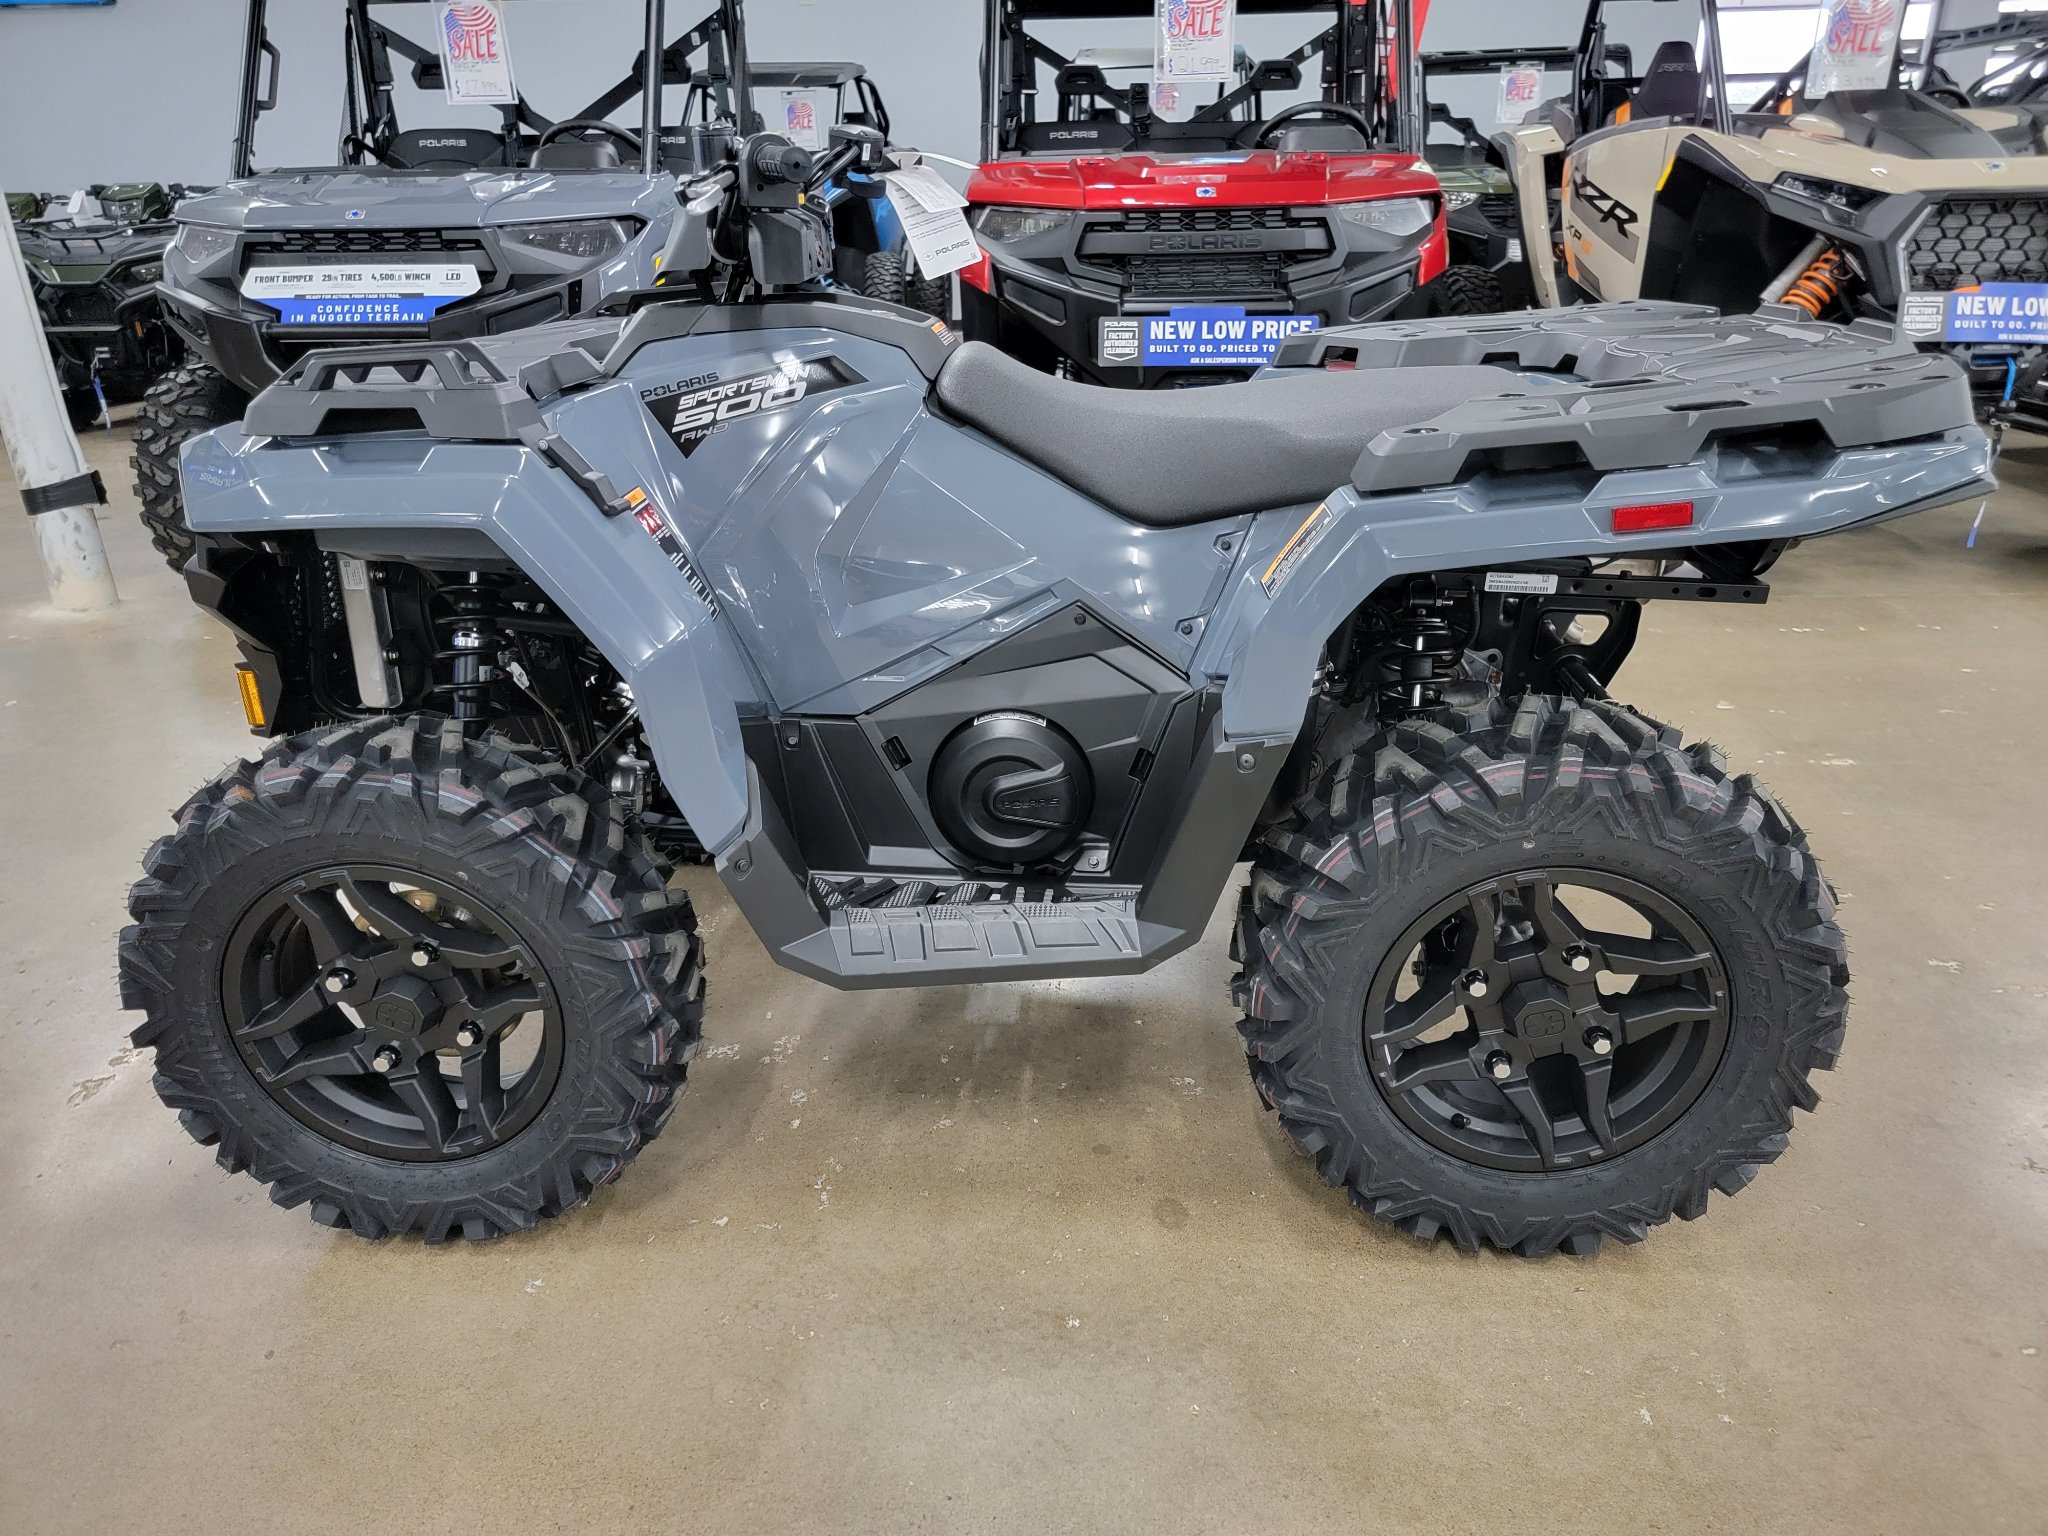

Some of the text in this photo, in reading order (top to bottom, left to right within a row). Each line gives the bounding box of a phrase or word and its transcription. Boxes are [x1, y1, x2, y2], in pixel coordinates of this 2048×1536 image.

[1170, 5, 1224, 38] SALE
[1827, 21, 1887, 53] SALE
[451, 29, 498, 60] SALE
[1505, 86, 1535, 102] SALE
[788, 114, 813, 130] SALE
[660, 136, 687, 144] ARIS
[1049, 130, 1099, 140] POLARIS
[418, 139, 468, 148] POLARIS
[1572, 166, 1639, 240] RZR
[935, 239, 971, 257] POLARIS
[1150, 233, 1263, 250] POLARIS
[254, 274, 314, 285] FRONT BUMPER
[340, 273, 363, 282] TIRES
[404, 272, 431, 281] WINCH
[445, 272, 461, 281] LED
[317, 304, 400, 314] CONFIDENCE
[1908, 307, 1938, 315] FACTORY
[1956, 296, 2007, 316] NEW
[290, 312, 424, 323] IN RUGGED TERRAIN
[1150, 320, 1313, 340] NEW LOW PRICE
[1954, 320, 2048, 330] BUILT TO GO. PRI
[1108, 332, 1134, 340] FACTORY
[1149, 344, 1276, 353] BUILT TO GO. PRICED TO
[639, 371, 720, 401] POLARIS
[671, 381, 808, 434] 500
[680, 422, 730, 443] AWD
[1001, 797, 1060, 810] POLARIS
